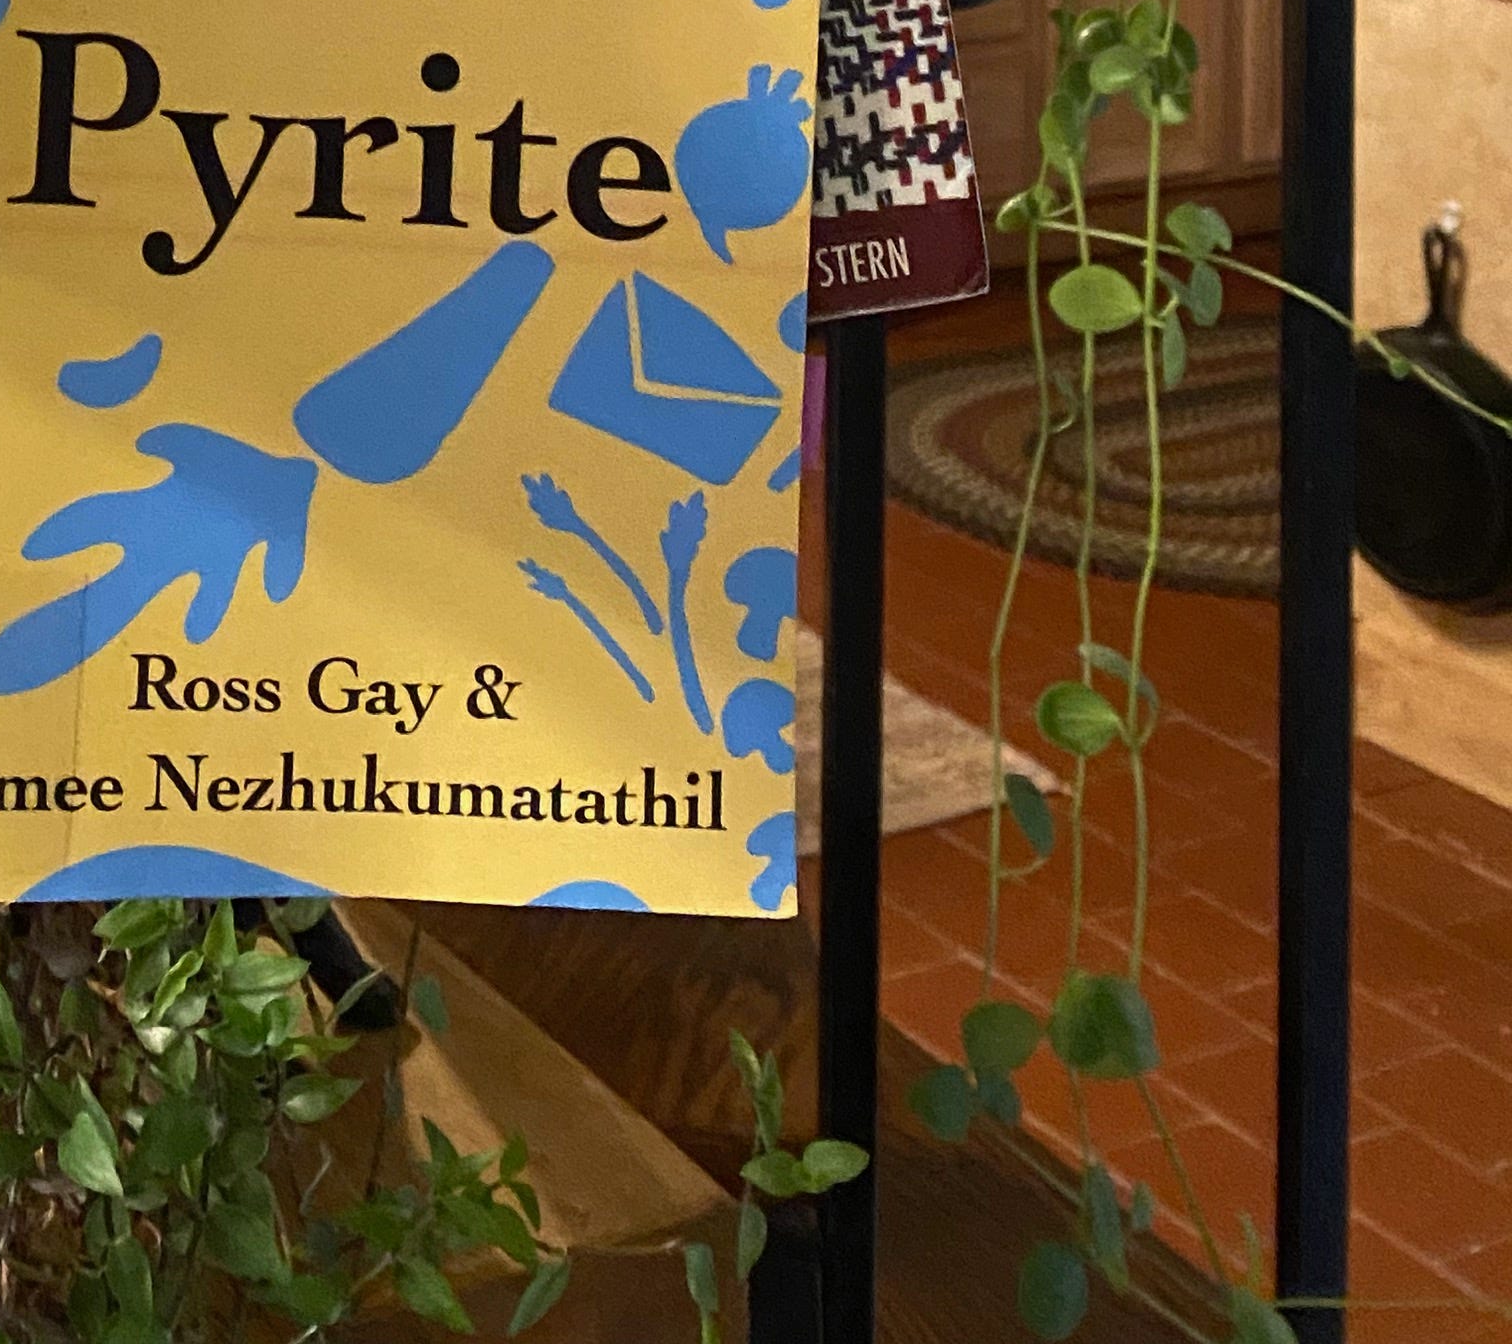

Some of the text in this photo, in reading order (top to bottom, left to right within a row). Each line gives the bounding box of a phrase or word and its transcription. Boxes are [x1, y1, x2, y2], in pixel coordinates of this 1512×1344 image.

[6, 30, 672, 277] Pyrite
[815, 236, 911, 288] STERN
[128, 653, 519, 735] Ross Gay &
[146, 751, 728, 832] Nezhukumatathil
